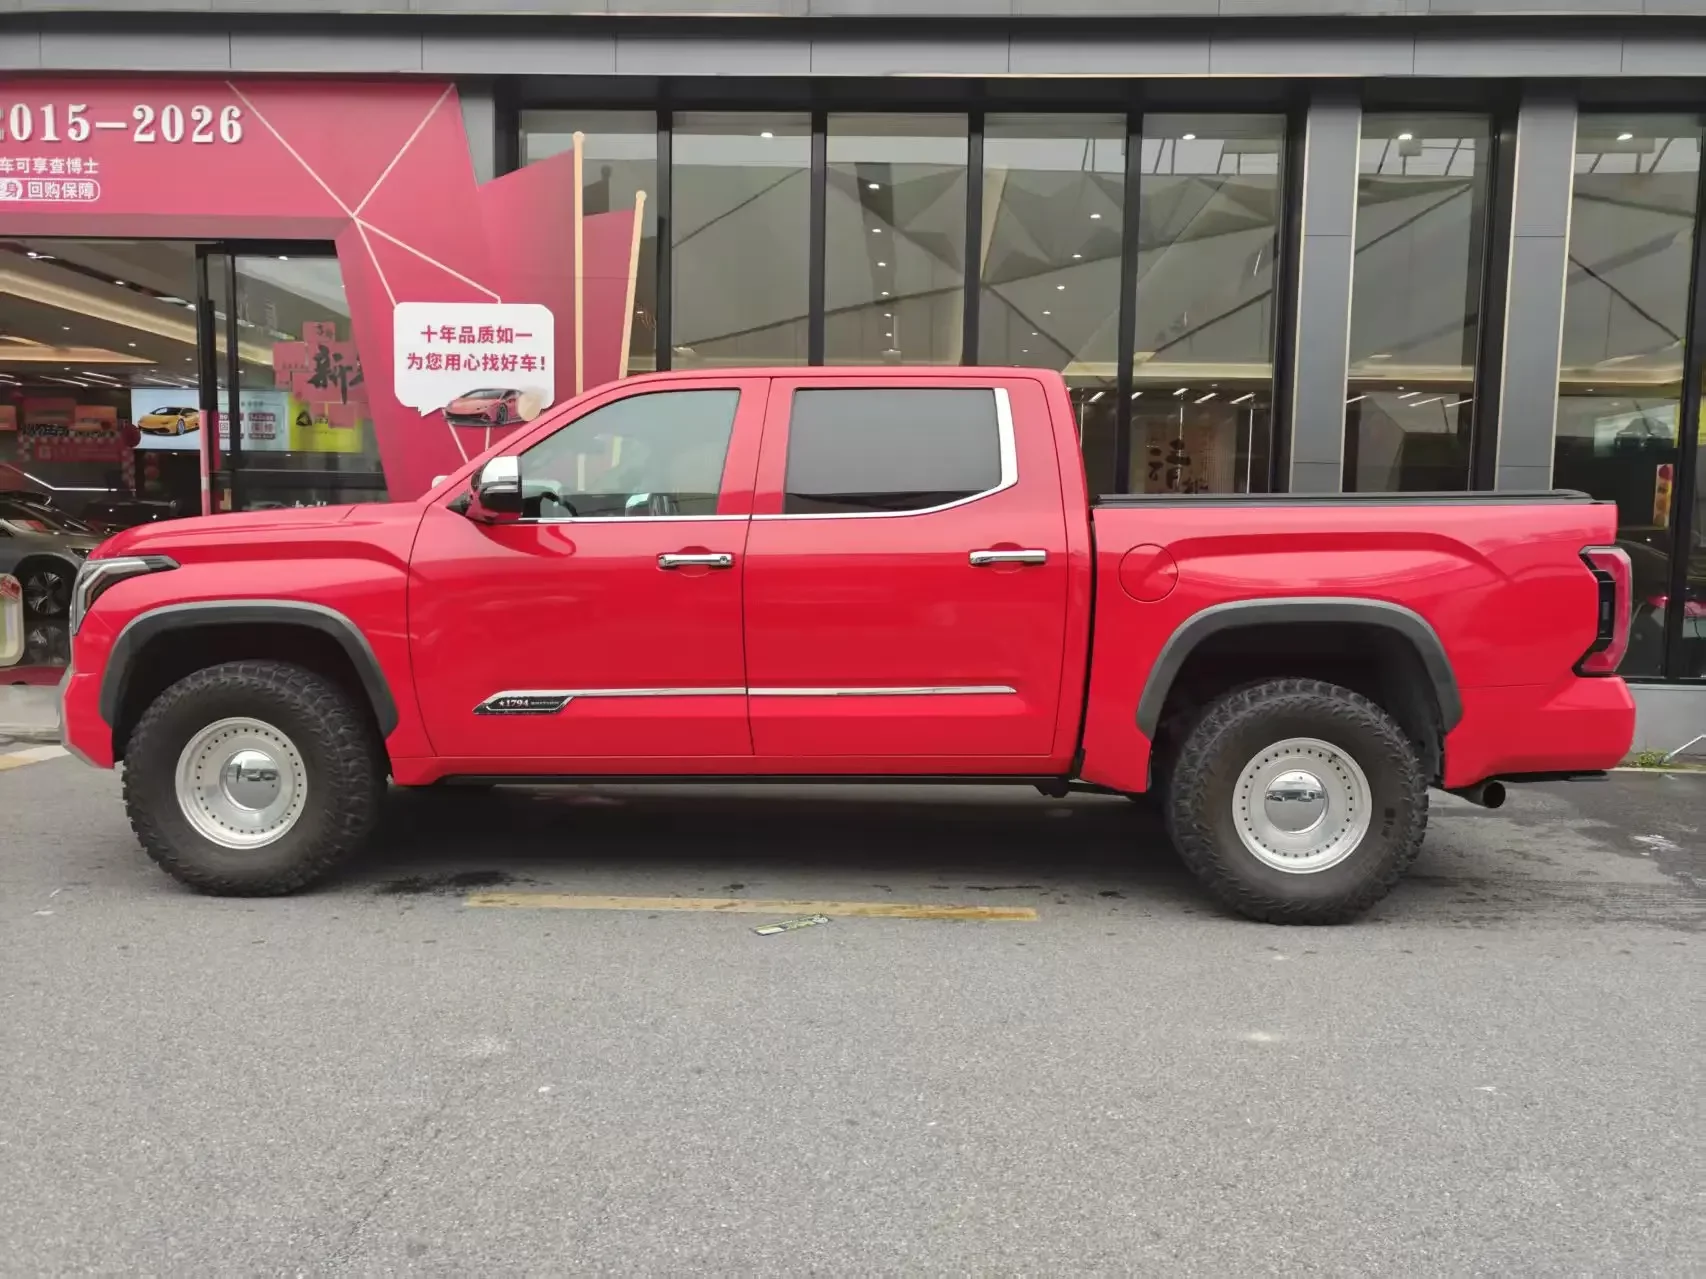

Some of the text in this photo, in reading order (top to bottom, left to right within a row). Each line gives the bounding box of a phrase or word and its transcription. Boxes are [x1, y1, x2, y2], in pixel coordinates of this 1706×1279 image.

[0, 103, 243, 144] 015—2026
[27, 181, 94, 199] 回购保障
[420, 325, 533, 344] 十年品质如一
[506, 699, 529, 708] 1794
